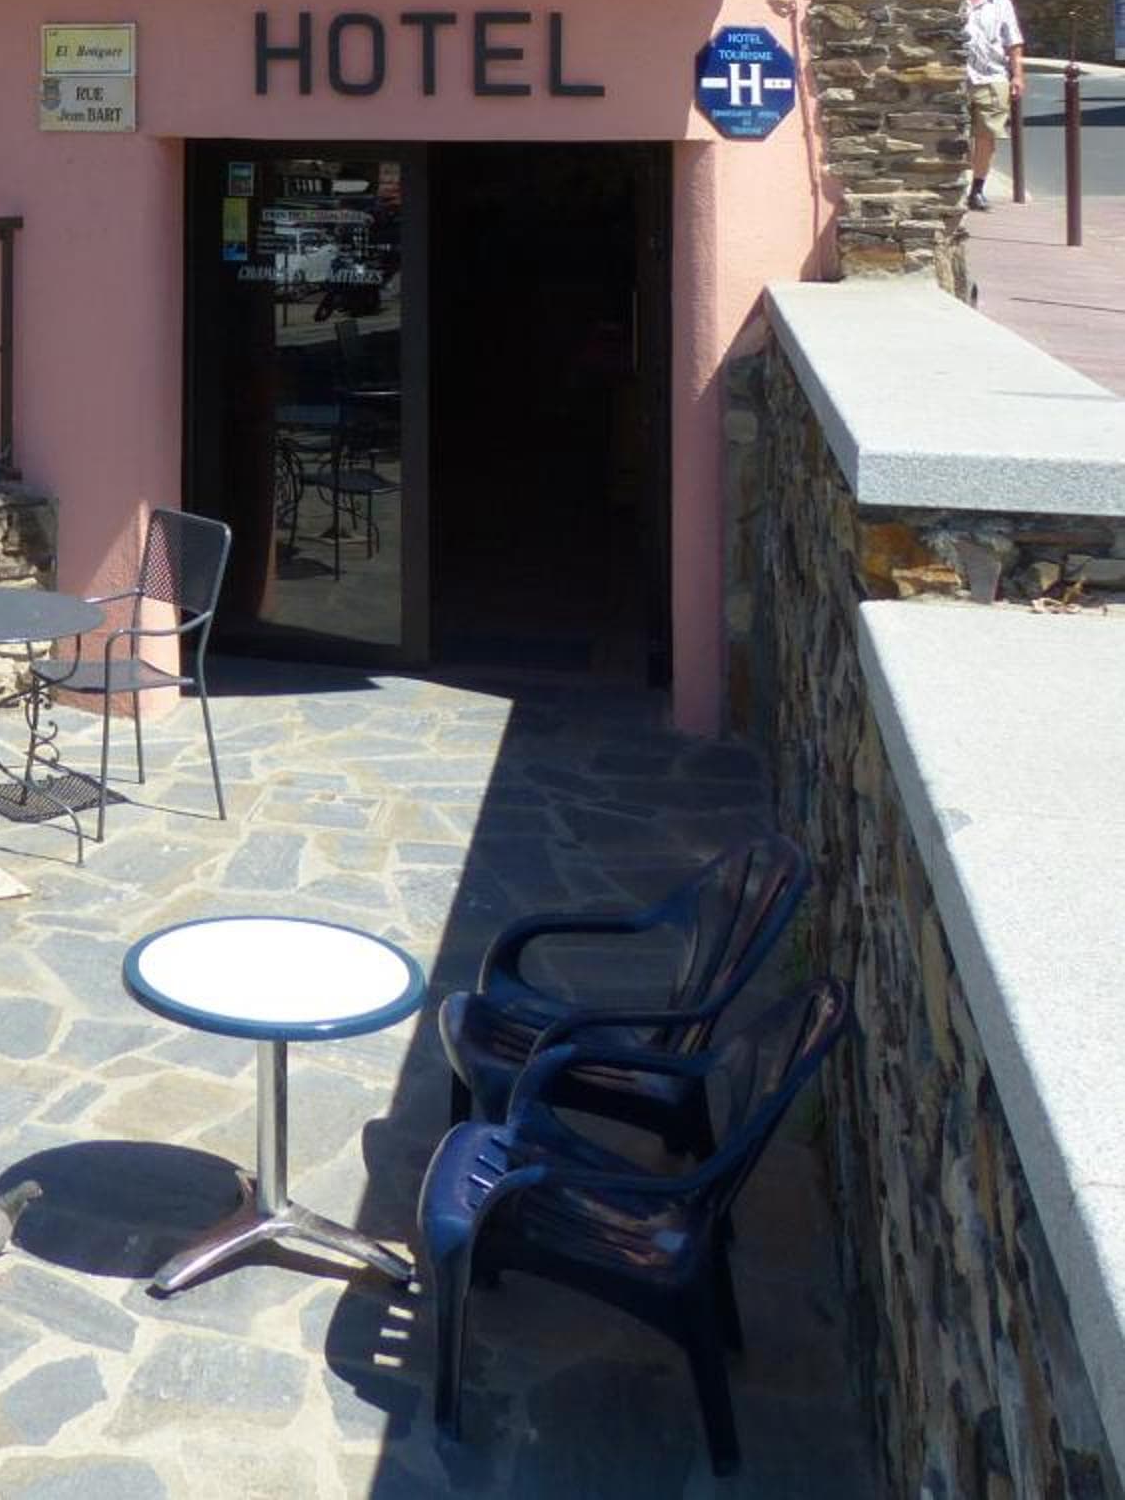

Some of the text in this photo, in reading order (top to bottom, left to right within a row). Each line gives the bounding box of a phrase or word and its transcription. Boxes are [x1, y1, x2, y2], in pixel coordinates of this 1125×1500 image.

[728, 33, 763, 45] HOTEL
[255, 12, 605, 97] HOTEL
[718, 50, 773, 61] TOURISME
[729, 63, 763, 106] H
[76, 86, 104, 101] RUE
[87, 106, 124, 122] BART
